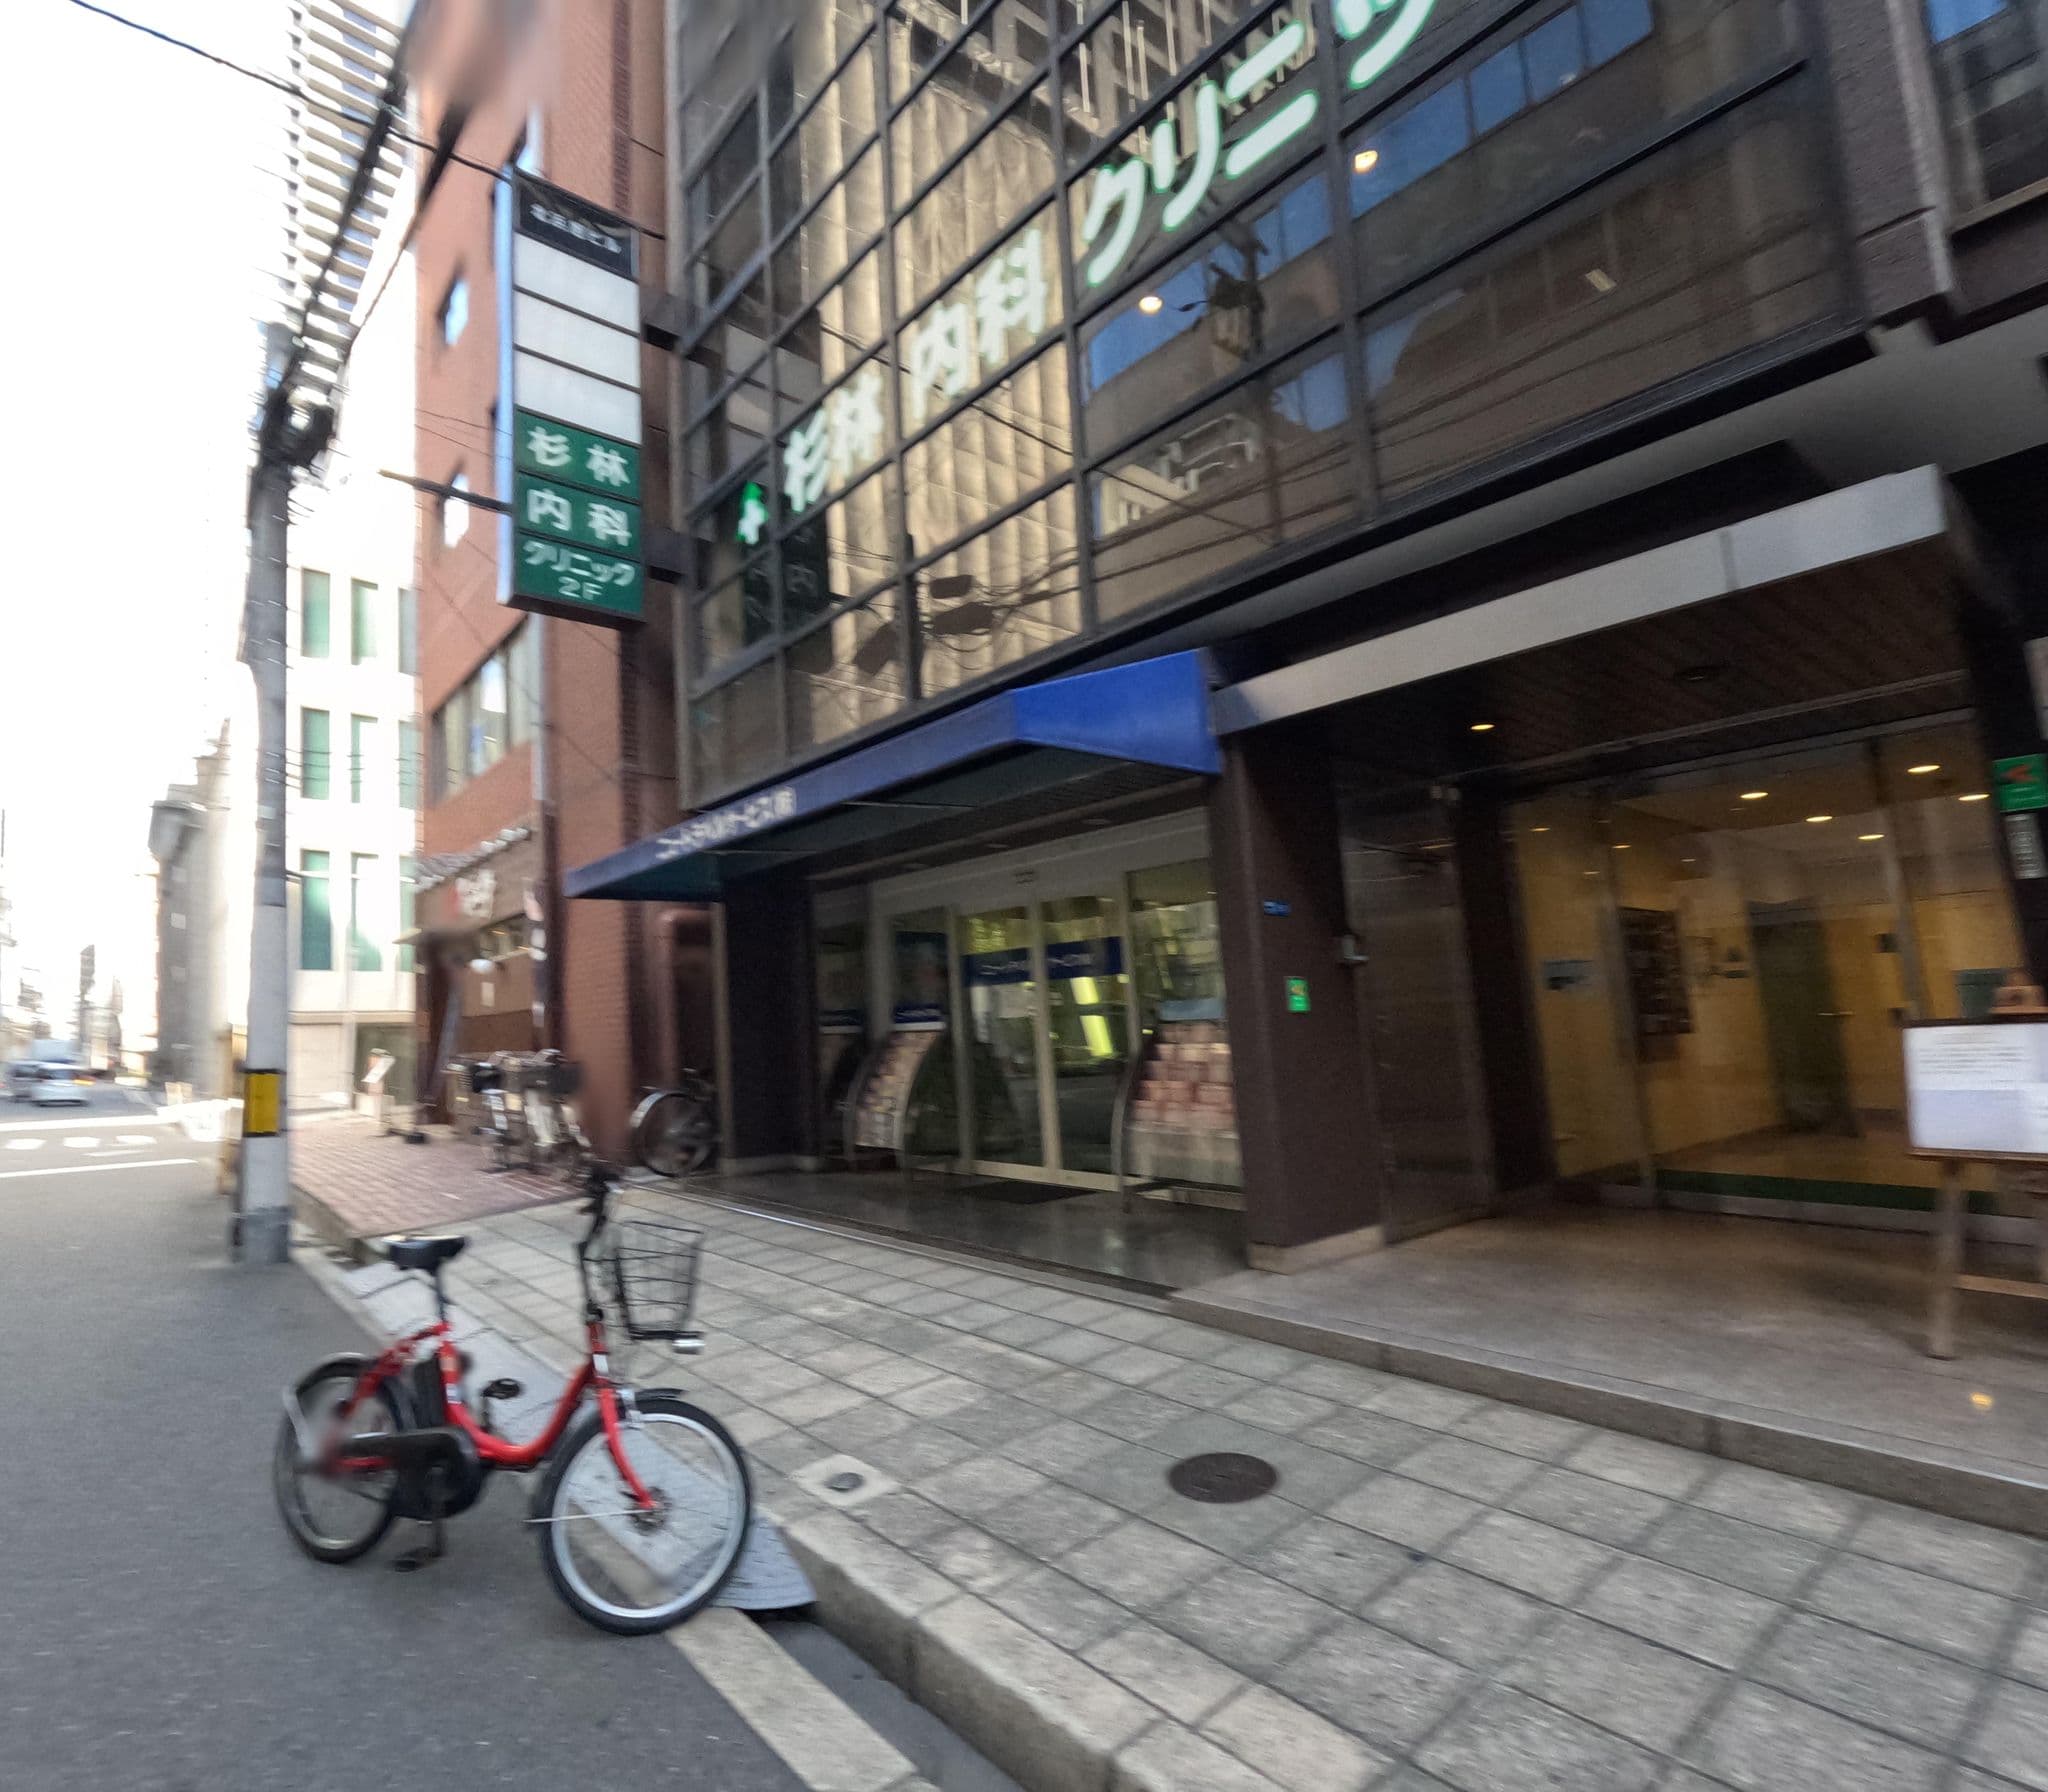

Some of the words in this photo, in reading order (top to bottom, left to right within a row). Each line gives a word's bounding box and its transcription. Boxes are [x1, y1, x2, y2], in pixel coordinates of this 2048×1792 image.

[527, 426, 631, 487] 杉林
[527, 487, 632, 547] 内科
[523, 540, 635, 587] クリニック
[558, 576, 604, 601] 2F
